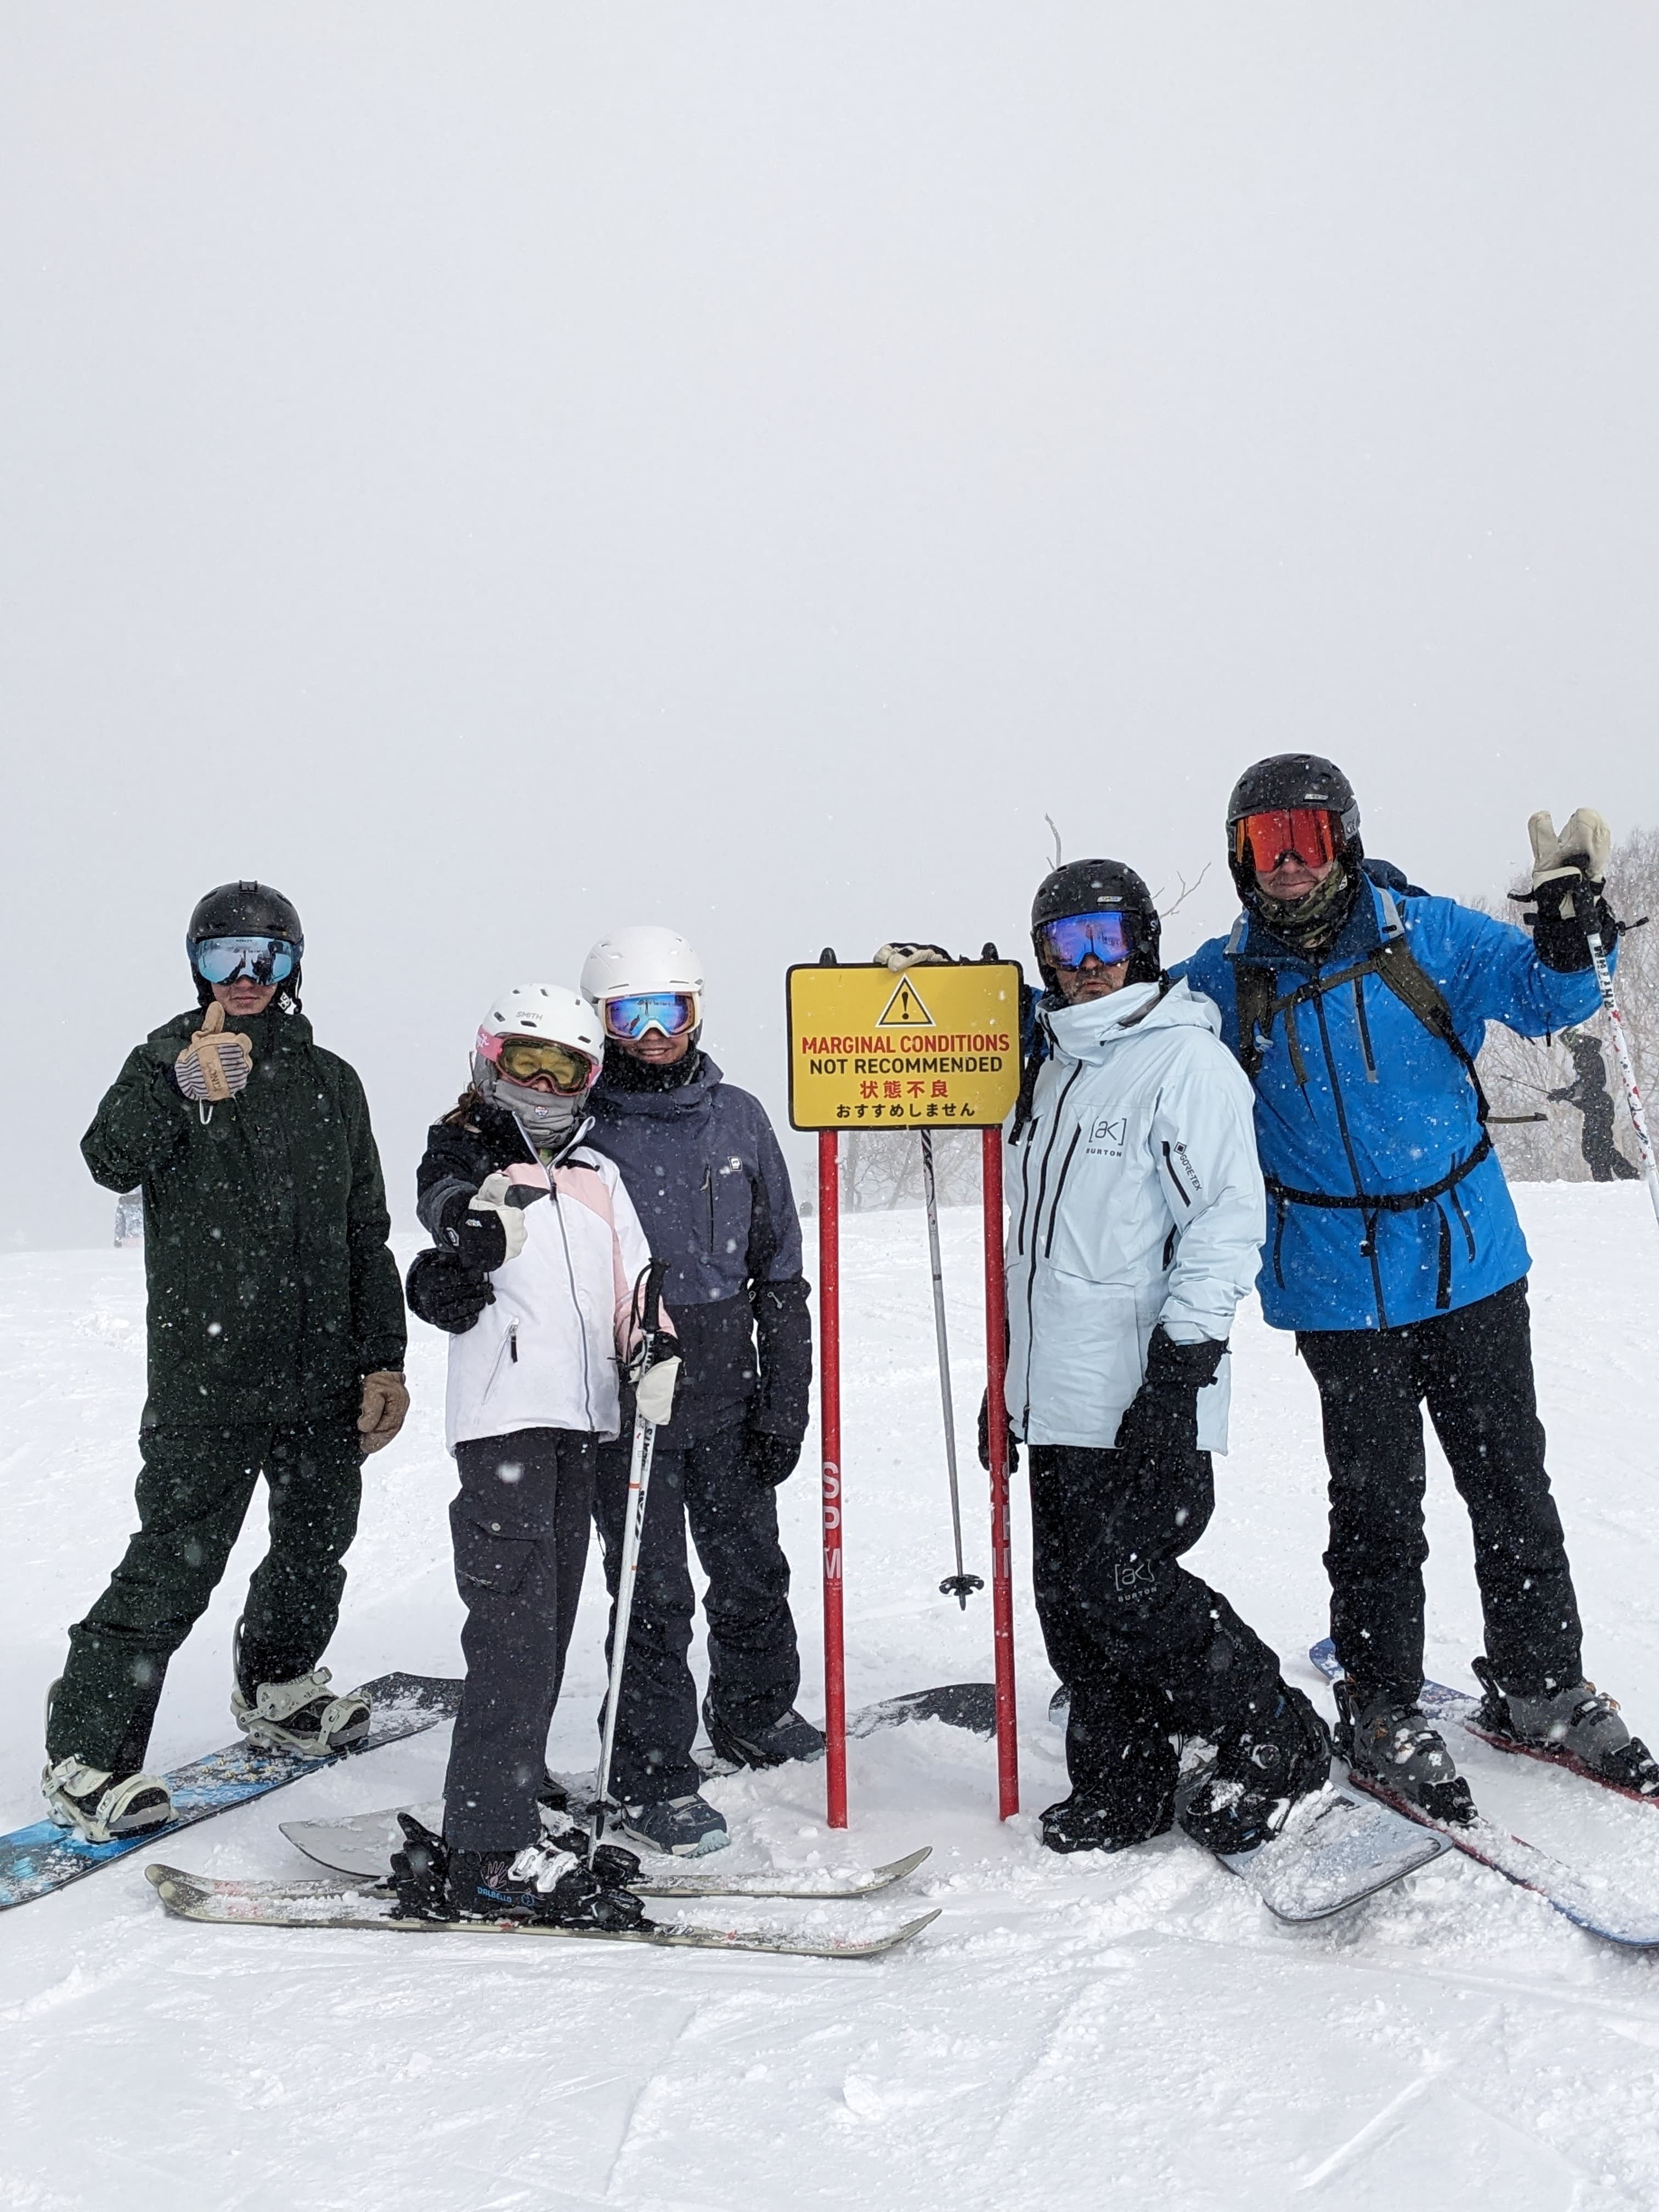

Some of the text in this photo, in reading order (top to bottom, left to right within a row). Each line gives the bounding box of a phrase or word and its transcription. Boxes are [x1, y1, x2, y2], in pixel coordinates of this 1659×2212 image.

[516, 1011, 543, 1020] SMITH
[802, 1034, 1010, 1054] MARGINAL CONDITIONS
[810, 1057, 1002, 1075] NOT RECOMMENDED
[860, 1080, 949, 1099] 状態不良
[836, 1103, 975, 1118] おすすめしません
[1086, 1148, 1122, 1158] BURTON
[1118, 1587, 1157, 1602] BURTON
[477, 1886, 512, 1903] DALBELLO
